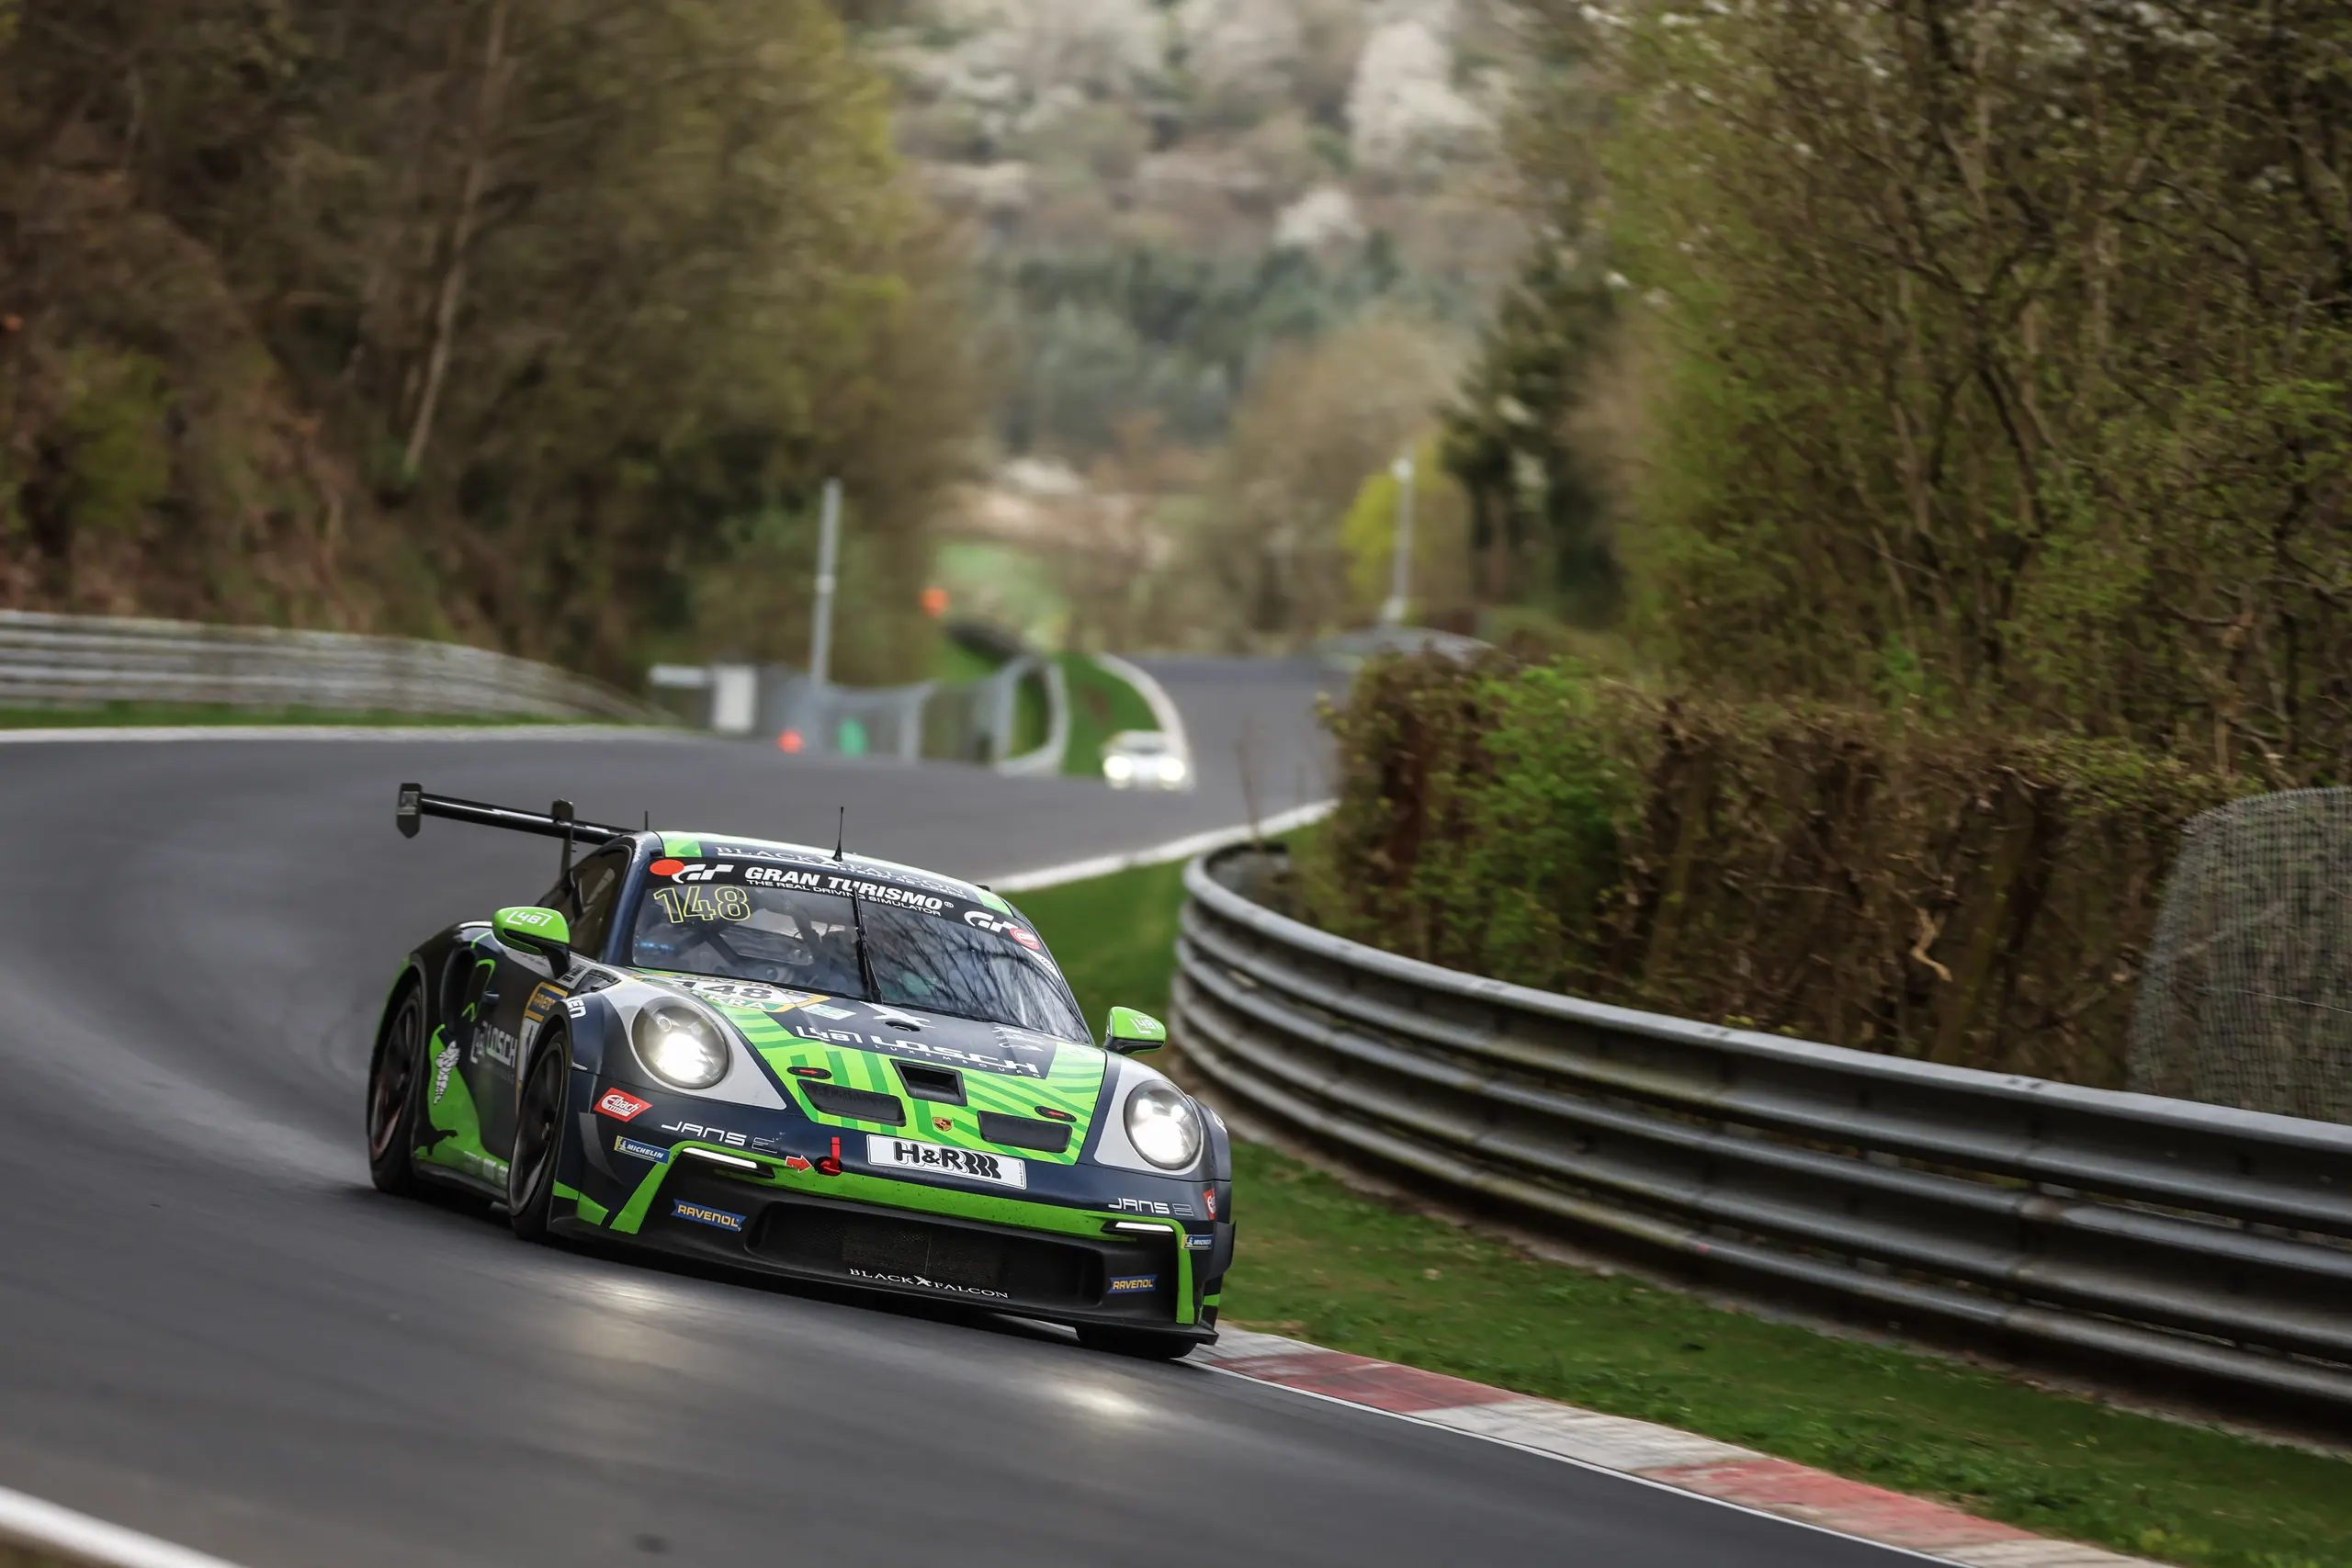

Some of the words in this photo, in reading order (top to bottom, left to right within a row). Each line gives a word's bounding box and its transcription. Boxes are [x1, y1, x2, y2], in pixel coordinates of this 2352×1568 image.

[745, 866, 820, 886] GRAN
[653, 886, 751, 923] 148
[776, 883, 811, 892] REAL
[868, 896, 941, 917] SIMULATOR
[870, 1035, 1040, 1074] LOSCH
[875, 1043, 1041, 1078] LUXEMBOURG
[601, 1094, 640, 1117] Eibach
[627, 1144, 664, 1159] MICHELIN
[677, 1204, 739, 1228] RAVENOL
[849, 1269, 914, 1285] BLACK
[934, 1282, 1009, 1298] FALCON
[1113, 1279, 1154, 1290] RAVENOL
